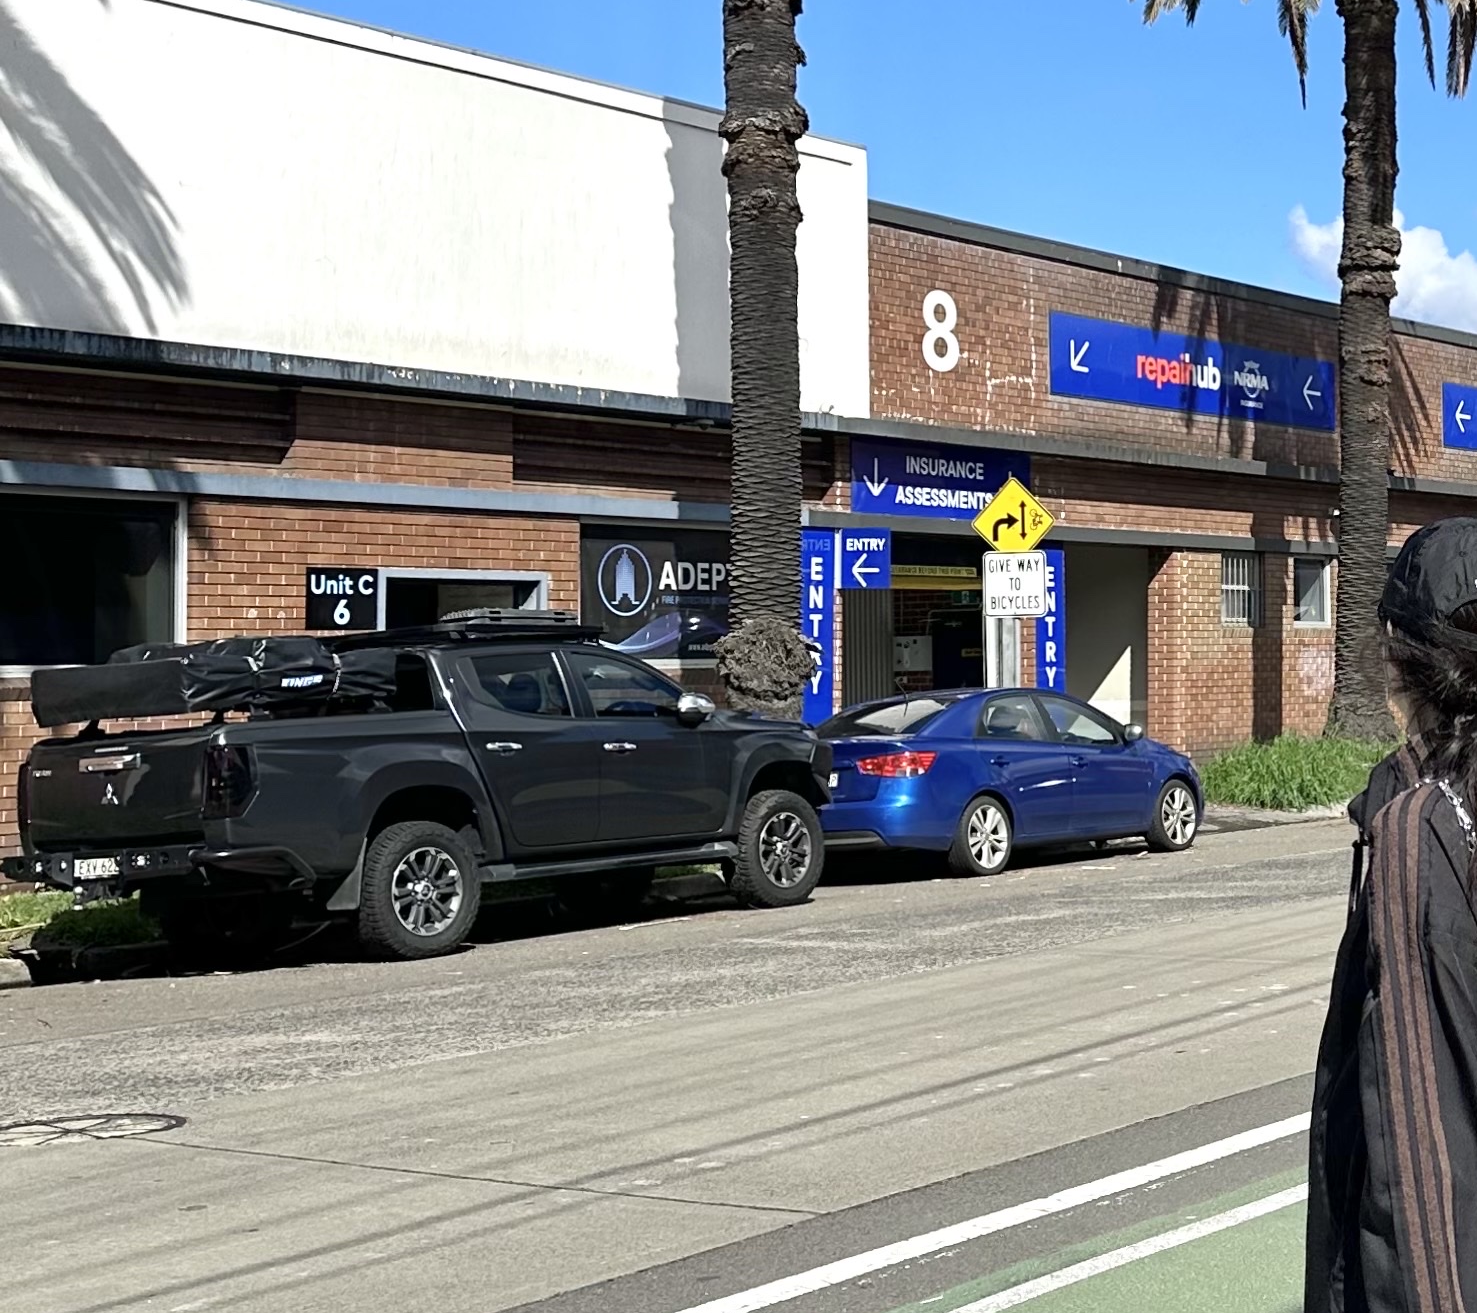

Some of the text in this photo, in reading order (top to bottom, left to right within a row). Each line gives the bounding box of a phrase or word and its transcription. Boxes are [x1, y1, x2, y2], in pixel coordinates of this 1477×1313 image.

[922, 289, 960, 372] 8
[1234, 371, 1269, 390] NRMA
[906, 455, 984, 480] INSURANCE
[895, 485, 992, 510] ASSESSMENTS
[845, 538, 886, 551] ENTRY
[988, 559, 1011, 573] GIVE
[1017, 559, 1040, 572] WAY
[310, 574, 374, 595] Unit C
[1009, 577, 1021, 591] TO
[333, 599, 350, 625] 6
[990, 595, 1040, 610] BICYCLES
[1045, 566, 1057, 688] ENTRY
